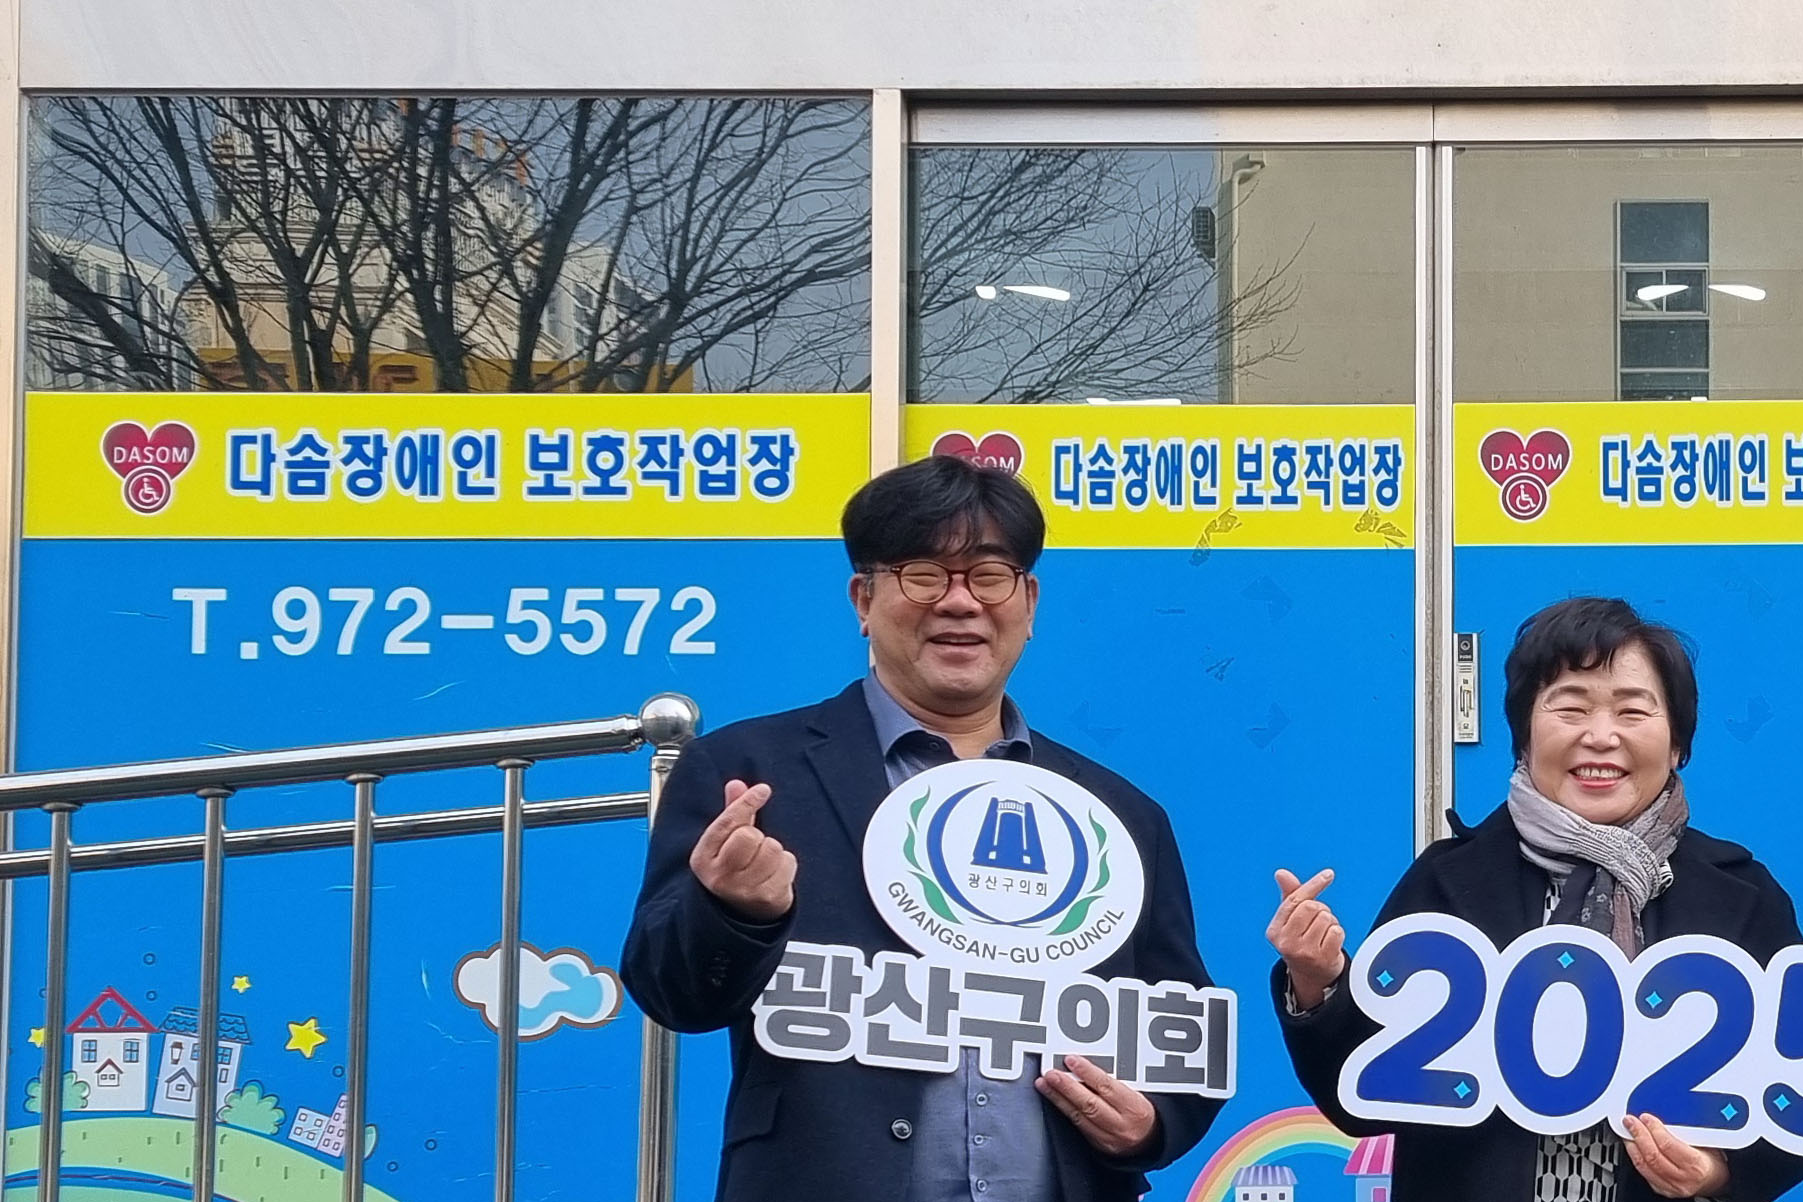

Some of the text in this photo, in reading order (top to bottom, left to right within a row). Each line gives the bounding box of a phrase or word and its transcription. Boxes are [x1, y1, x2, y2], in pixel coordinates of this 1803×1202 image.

[112, 446, 190, 465] DASOM
[229, 432, 796, 498] 다솜장애인 보호작업장
[1054, 442, 1402, 506] 다솜장애인 보호작업장
[1491, 452, 1564, 471] DASOM
[1601, 438, 1767, 502] 다솜장애인
[968, 873, 1047, 896] 광산구의회
[887, 881, 1125, 964] GWANGSAN-GU COUNCIL
[761, 950, 1230, 1090] 광산구의회
